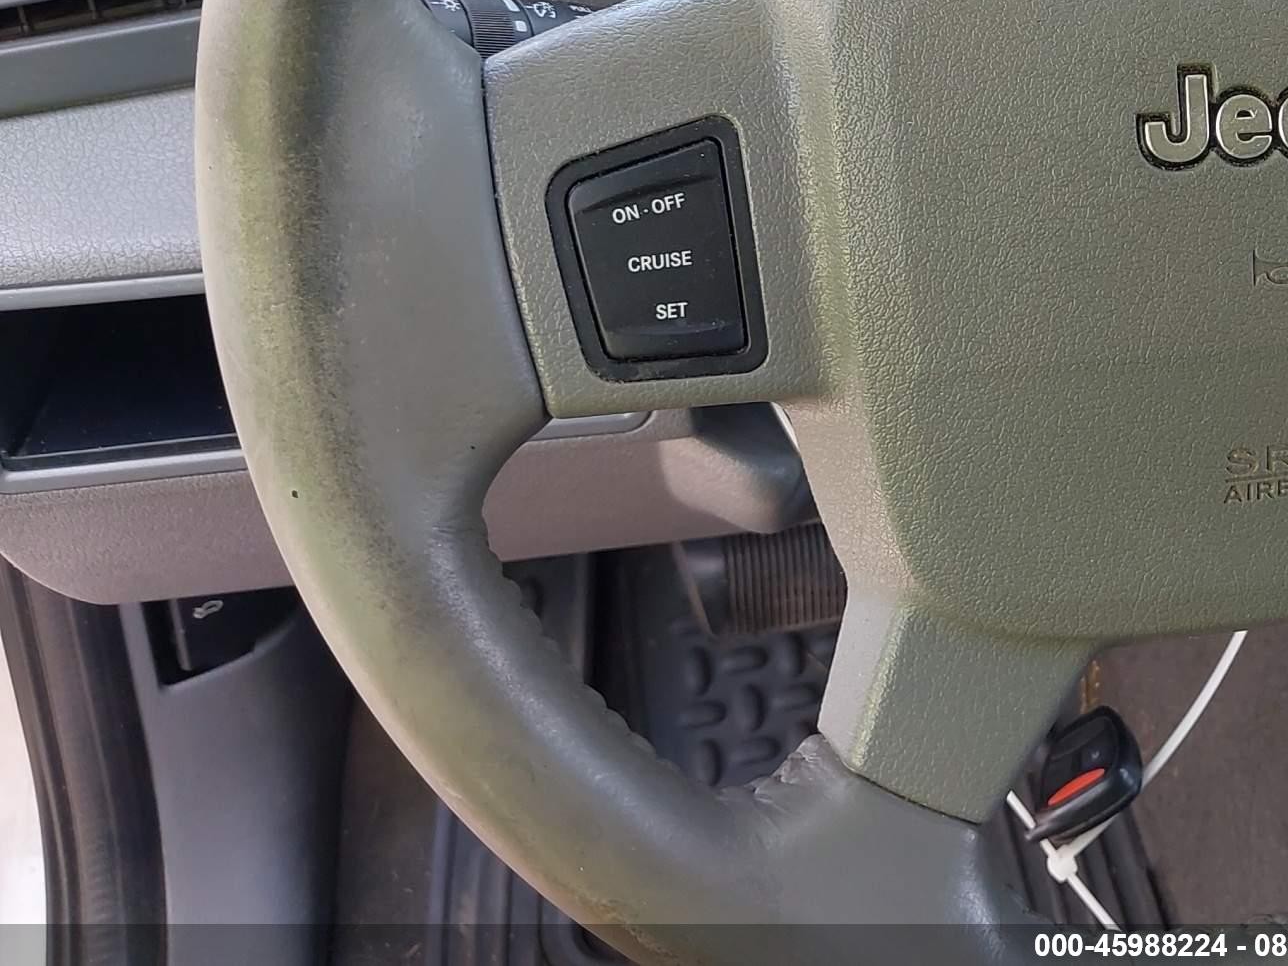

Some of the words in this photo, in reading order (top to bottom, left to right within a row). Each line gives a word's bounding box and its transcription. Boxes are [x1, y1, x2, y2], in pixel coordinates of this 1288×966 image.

[612, 204, 641, 224] ON
[651, 192, 686, 215] OFF
[628, 250, 693, 273] CRUISE
[655, 301, 689, 320] SET
